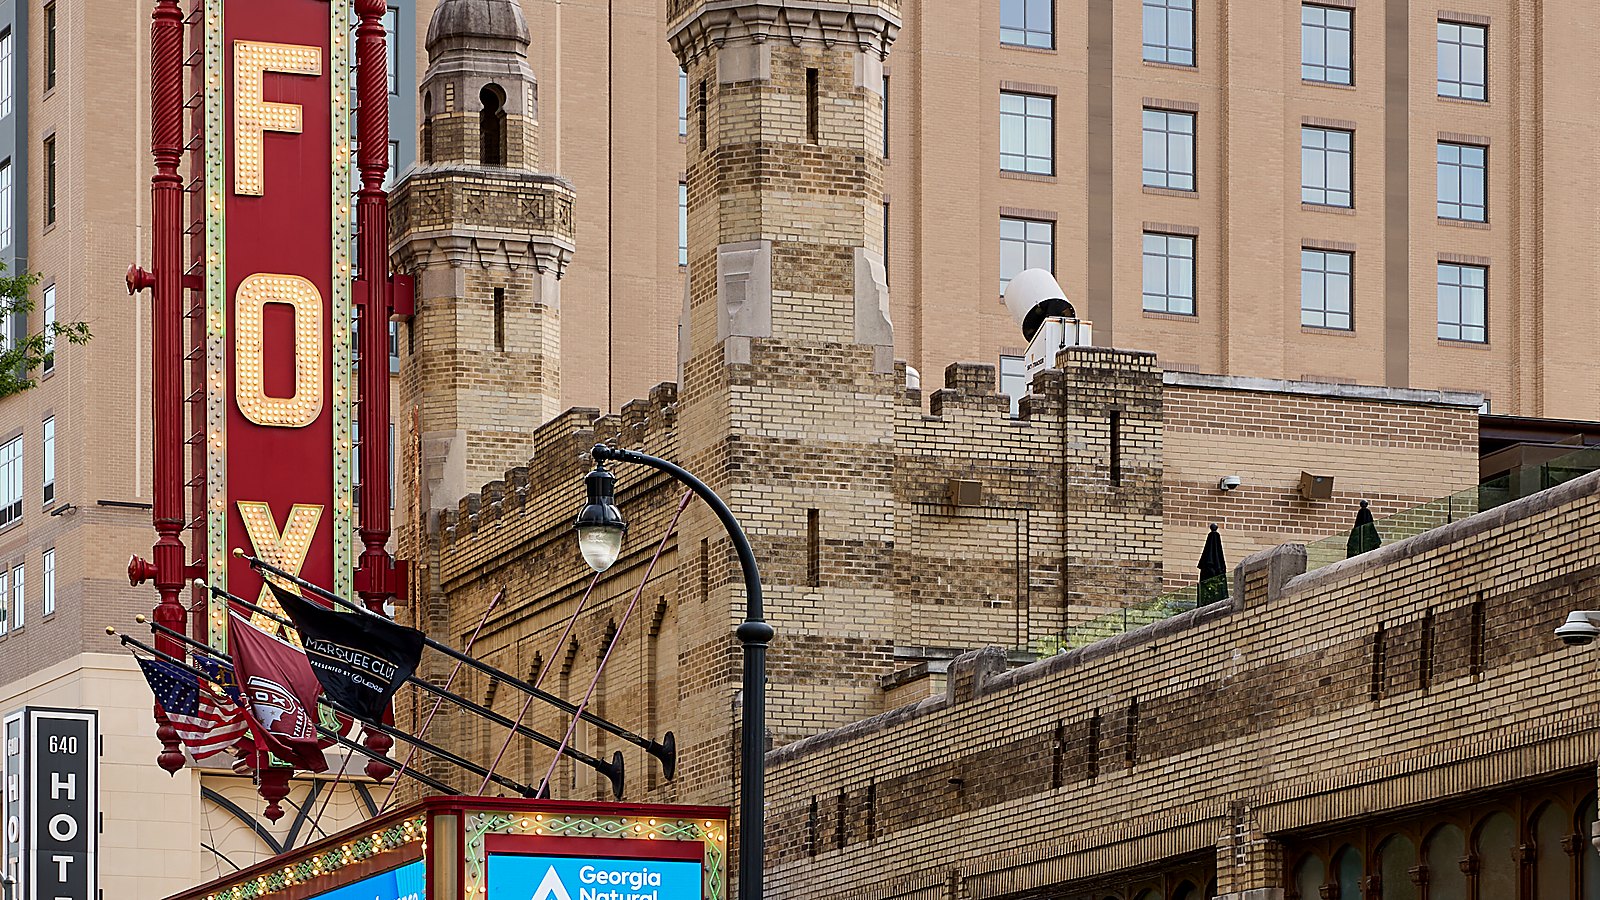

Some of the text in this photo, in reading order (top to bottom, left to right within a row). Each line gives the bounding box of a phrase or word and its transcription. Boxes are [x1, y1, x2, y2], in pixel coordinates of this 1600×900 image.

[232, 39, 325, 655] FOX
[305, 636, 370, 668] MARQUEE
[310, 660, 342, 674] PRESENTED
[251, 690, 286, 707] OX
[49, 735, 78, 754] 640
[48, 772, 78, 900] HOT
[579, 865, 662, 891] Georgia
